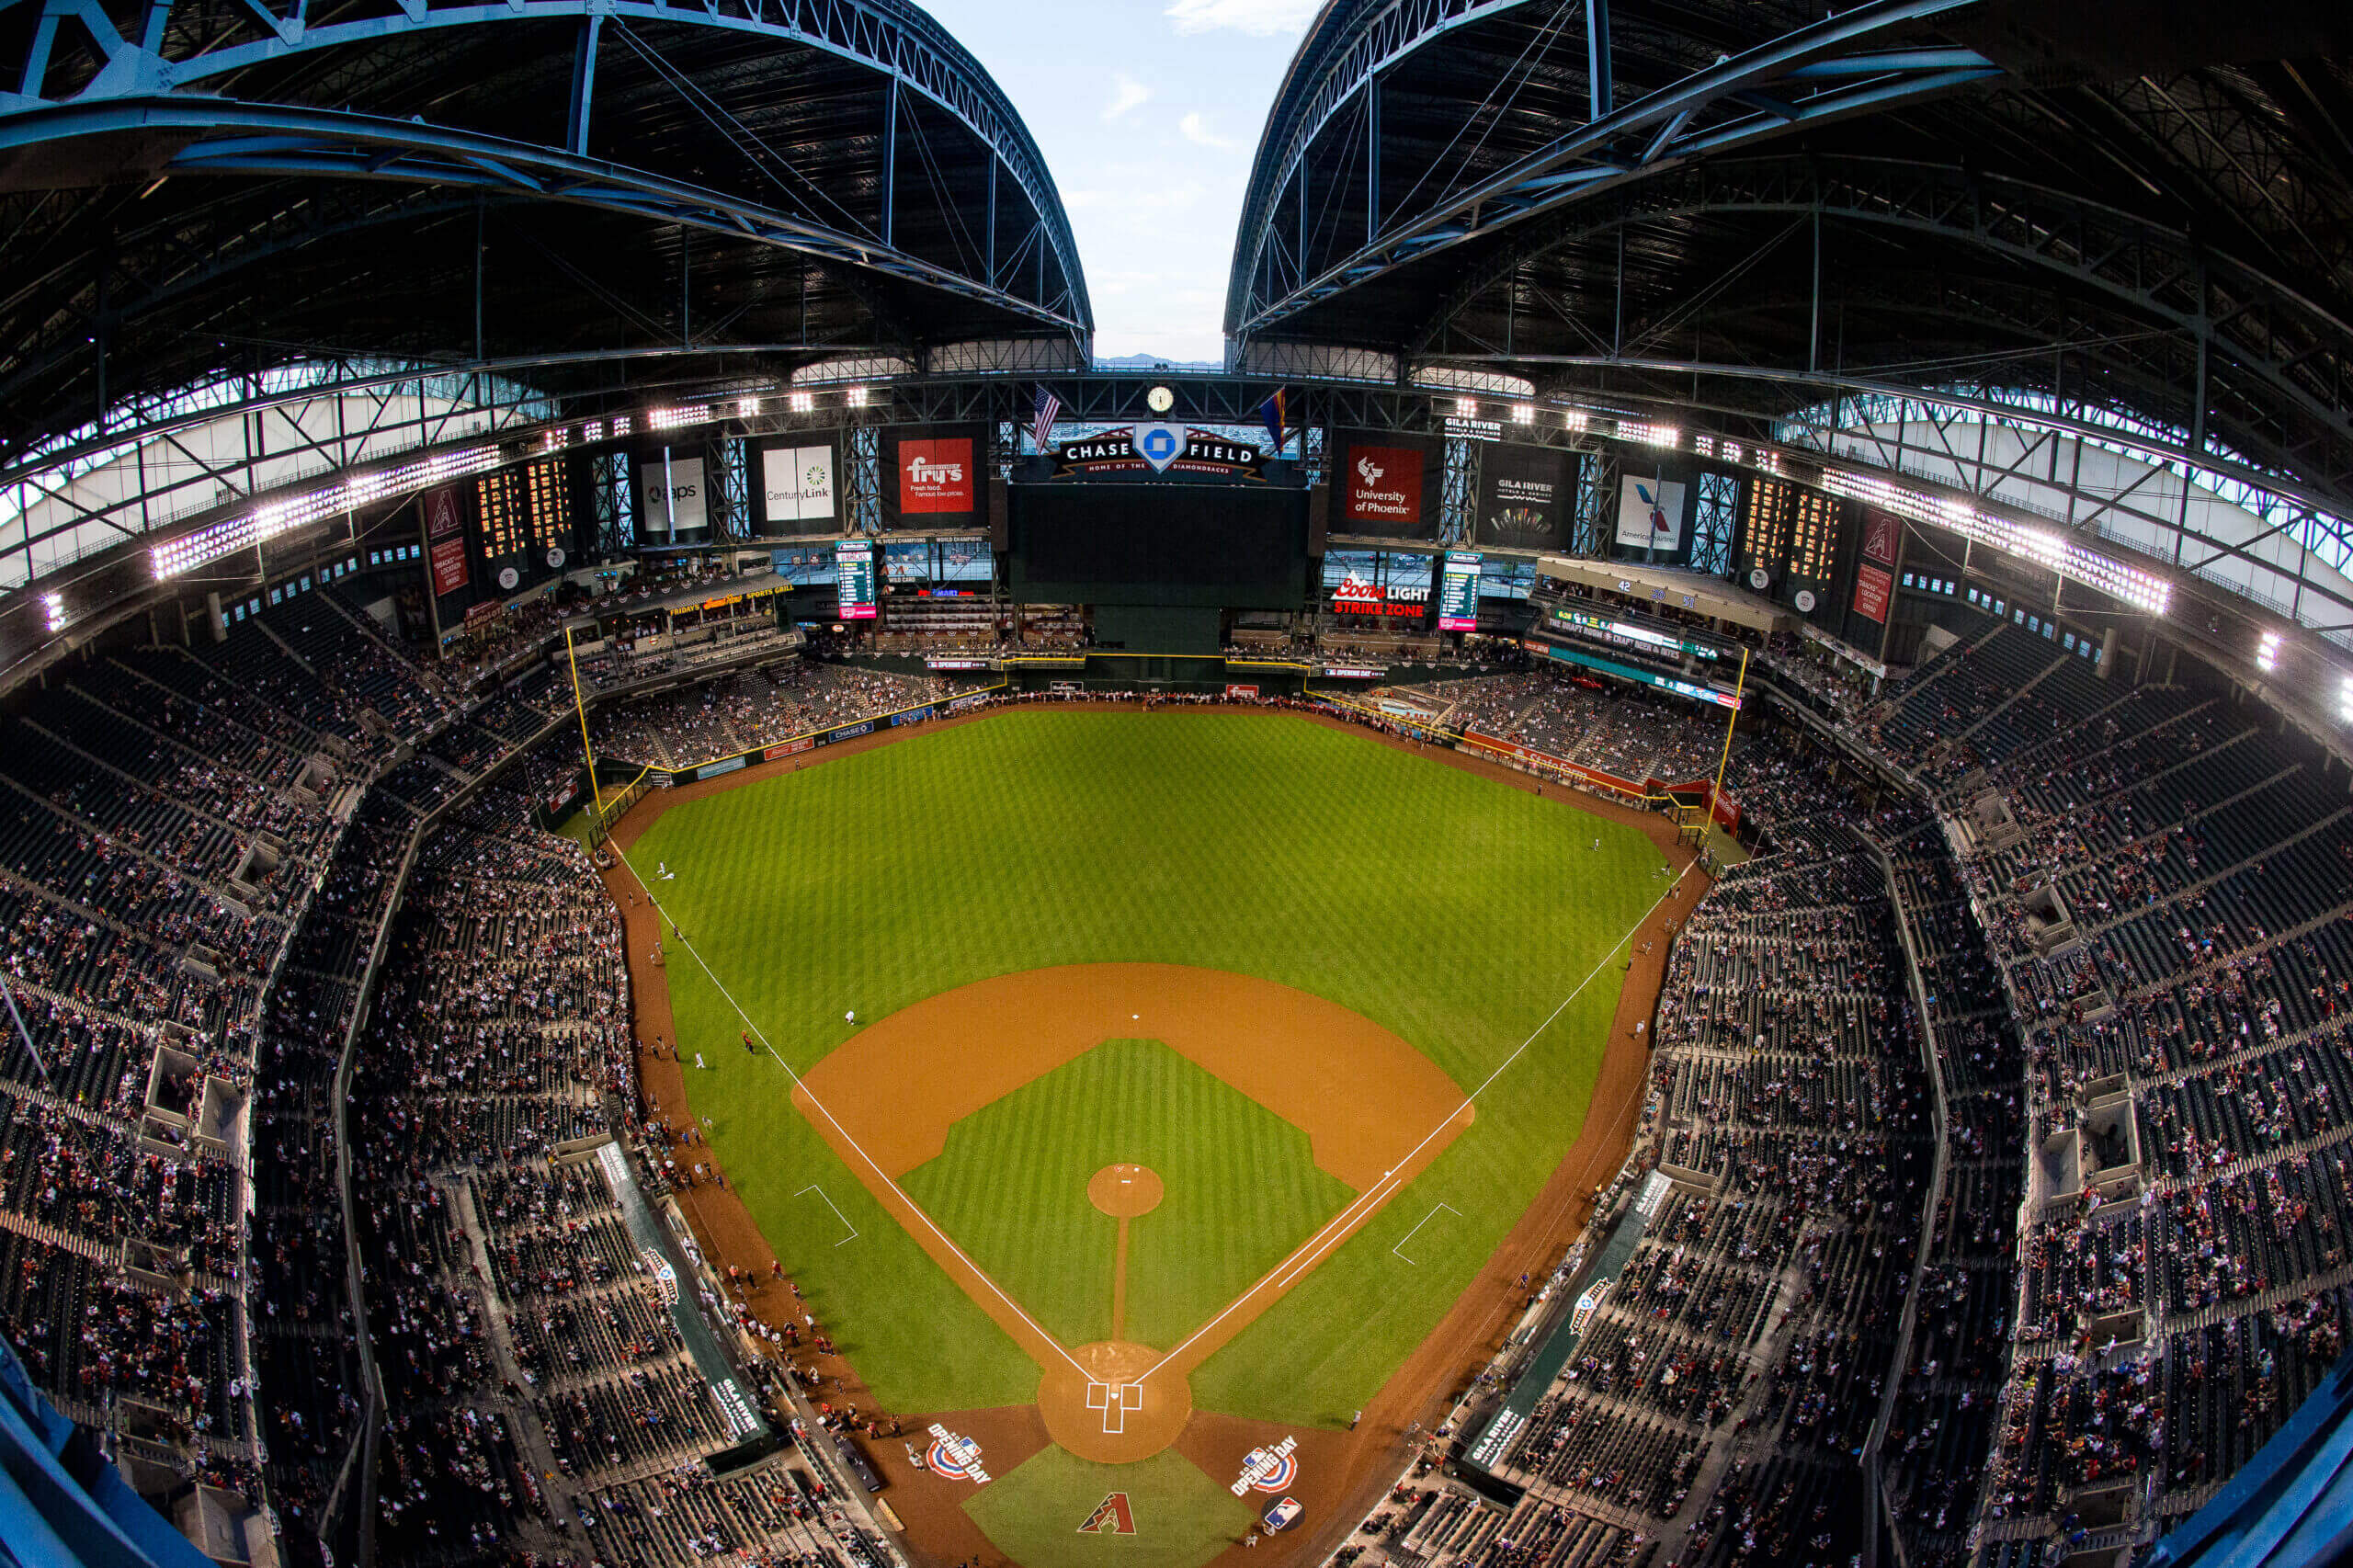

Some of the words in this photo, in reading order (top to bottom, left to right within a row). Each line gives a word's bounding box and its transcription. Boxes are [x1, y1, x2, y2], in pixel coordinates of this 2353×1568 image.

[1445, 417, 1470, 428] GILA
[1471, 420, 1501, 431] RIVER
[1067, 443, 1130, 460] CHASE
[1190, 444, 1253, 462] FIELD
[906, 456, 962, 484] fry's
[1089, 463, 1111, 472] HOME
[1173, 463, 1229, 474] DIAMONDBACKS
[767, 487, 828, 501] CenturyLink
[1498, 479, 1521, 490] GILA
[1523, 482, 1552, 493] RIVER
[1356, 489, 1406, 505] University
[1355, 503, 1367, 512] of
[1368, 503, 1408, 515] Phoenix
[1336, 577, 1387, 599] Coors
[1387, 585, 1431, 602] LIGHT
[1618, 580, 1631, 593] 42
[1651, 588, 1665, 601] 20
[669, 604, 700, 617] FRIDAYS
[746, 587, 773, 599] SPORTS
[774, 584, 794, 595] GRILL
[1683, 596, 1695, 608] 51
[1334, 601, 1383, 616] STRIKE
[1385, 603, 1425, 619] ZONE
[1549, 617, 1561, 628] THE
[1561, 619, 1583, 634] DRAFT
[1584, 626, 1603, 640] ROOM
[1612, 633, 1634, 645] CRAFT
[950, 692, 990, 710] GEICO
[835, 727, 860, 739] CHASE
[665, 1279, 676, 1299] FIELD
[1573, 1310, 1586, 1328] CHASE
[1590, 1282, 1605, 1300] FIELD
[723, 1378, 741, 1402] GILA
[735, 1400, 758, 1431] RIVER
[1472, 1437, 1495, 1461] GILA
[1488, 1409, 1514, 1439] RIVER
[927, 1423, 972, 1467] OPENING
[965, 1462, 993, 1485] DAY
[1231, 1452, 1280, 1497] OPENING
[1274, 1435, 1299, 1460] DAY
